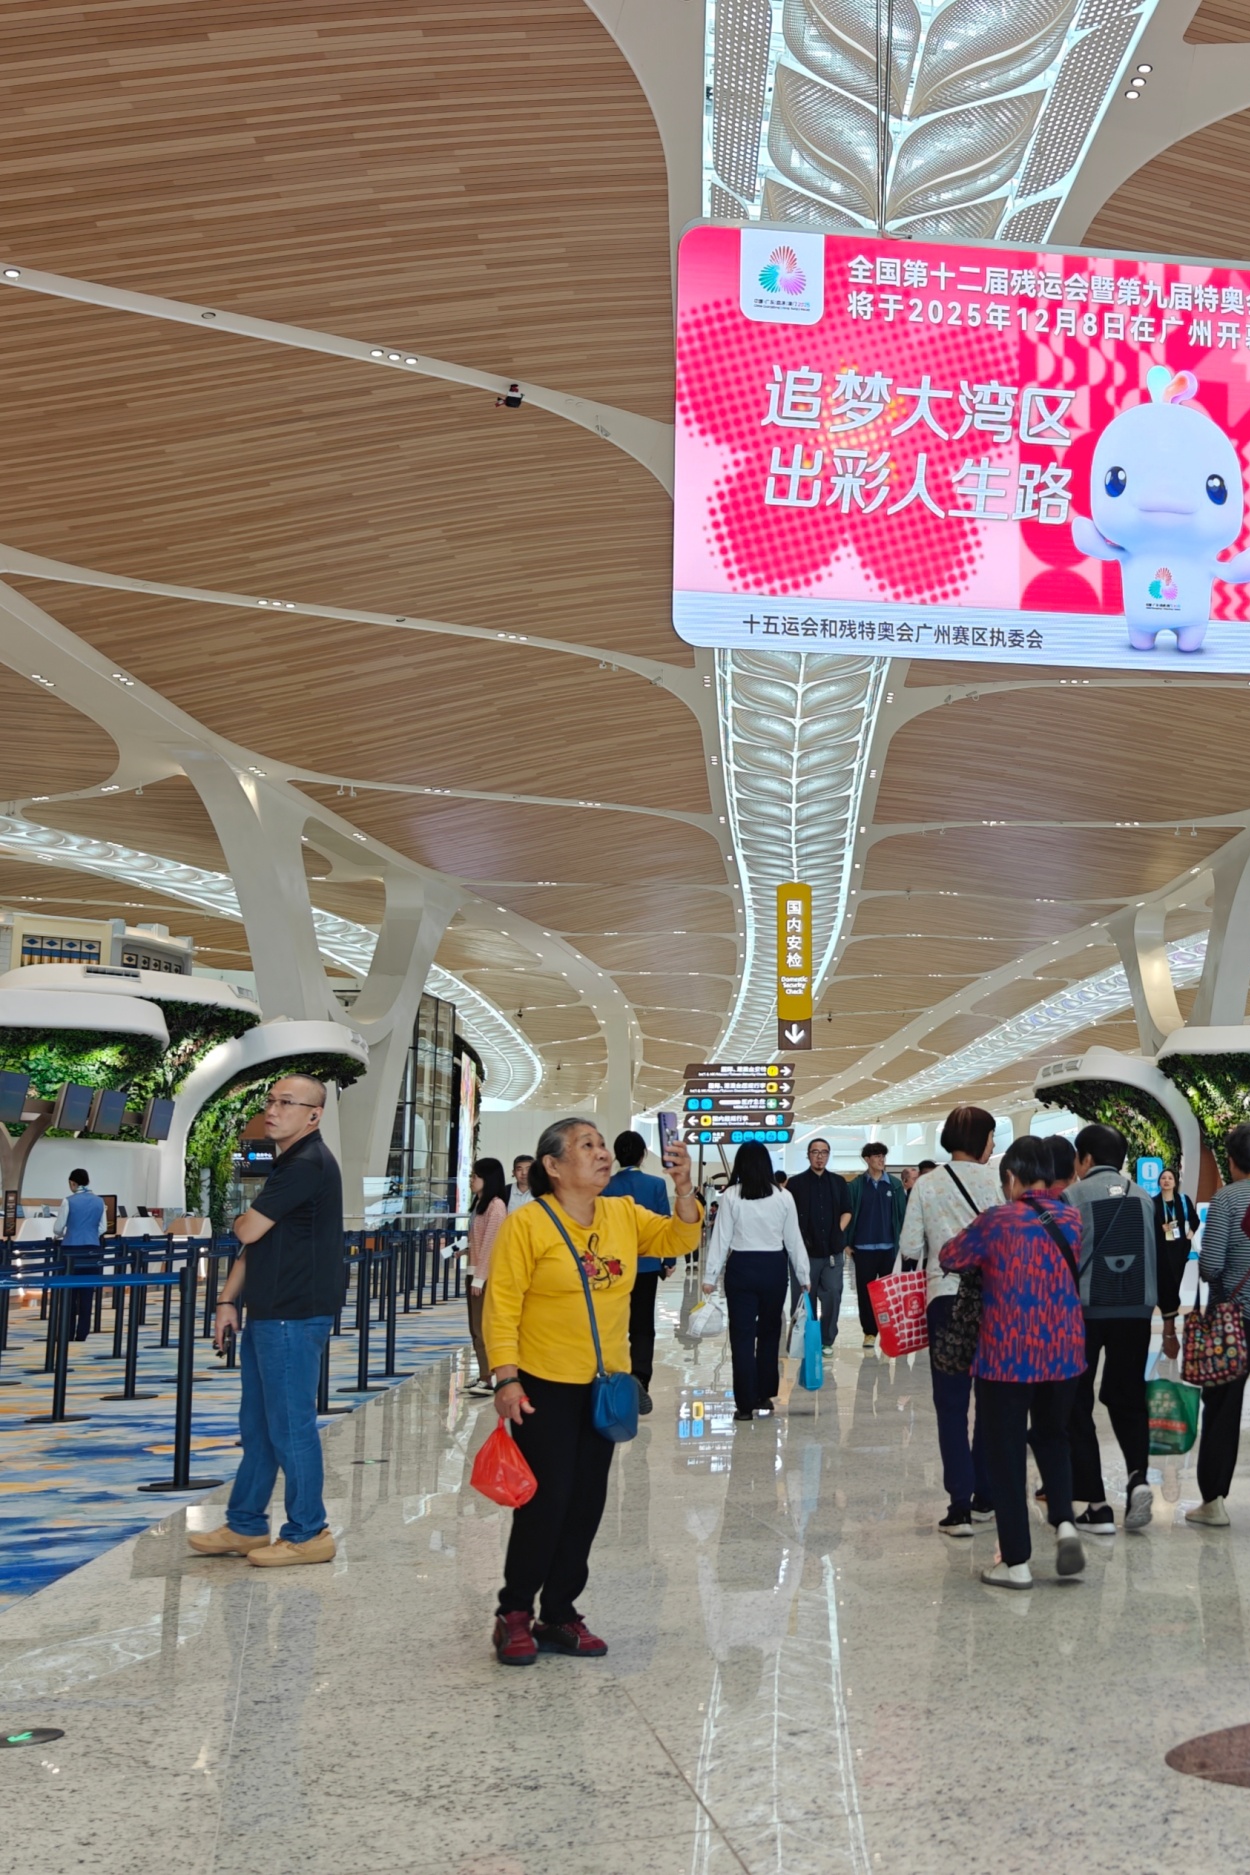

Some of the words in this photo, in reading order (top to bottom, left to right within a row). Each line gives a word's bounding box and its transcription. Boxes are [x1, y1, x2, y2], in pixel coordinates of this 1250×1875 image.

[760, 364, 1076, 447] 追梦大湾区
[764, 444, 1073, 525] 出彩人生路
[742, 613, 1044, 650] 十五运会和残特奥会广州赛区执委会
[786, 900, 803, 969] 国内安检
